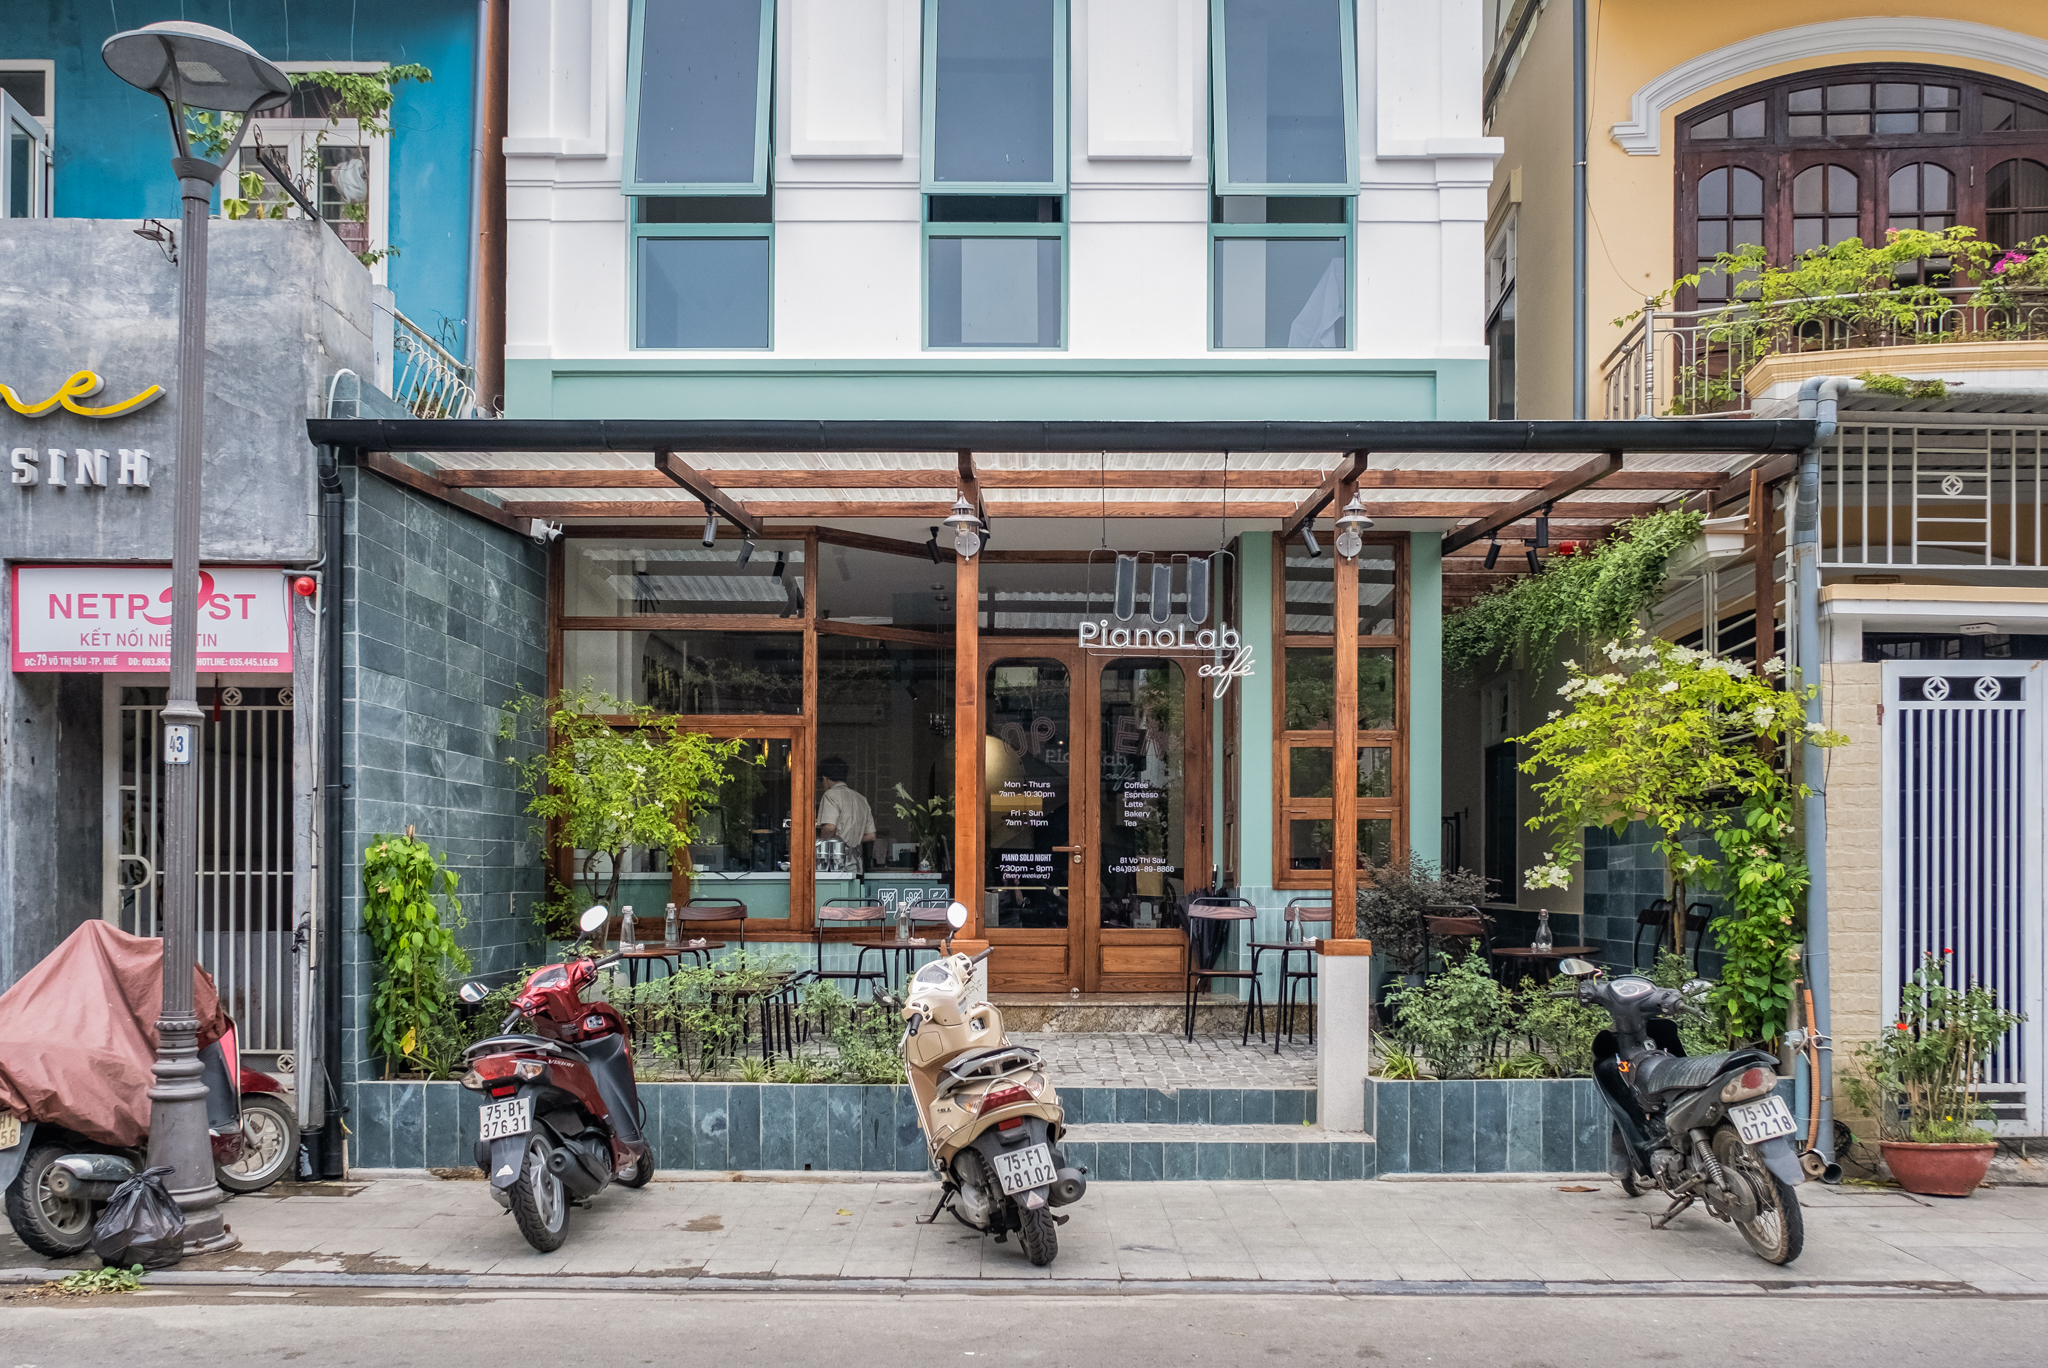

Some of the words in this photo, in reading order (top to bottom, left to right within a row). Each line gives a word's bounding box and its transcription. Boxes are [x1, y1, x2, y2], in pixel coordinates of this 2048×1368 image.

[11, 448, 150, 488] SINH
[80, 627, 111, 646] KẾT
[116, 628, 143, 646] NỐI
[149, 628, 172, 647] NIỀ
[1079, 620, 1241, 648] PianoLab
[37, 654, 47, 666] 79
[48, 656, 58, 666] VÕ
[104, 655, 118, 666] HUẾ
[197, 658, 228, 666] HOTLINE:
[1198, 645, 1256, 700] café
[170, 736, 184, 752] 43
[487, 1101, 521, 1121] 75-B1
[483, 1116, 526, 1138] 376.31
[1742, 1116, 1792, 1140] 072.18
[1004, 1149, 1042, 1171] 75-F1
[1004, 1165, 1053, 1191] 281.02
